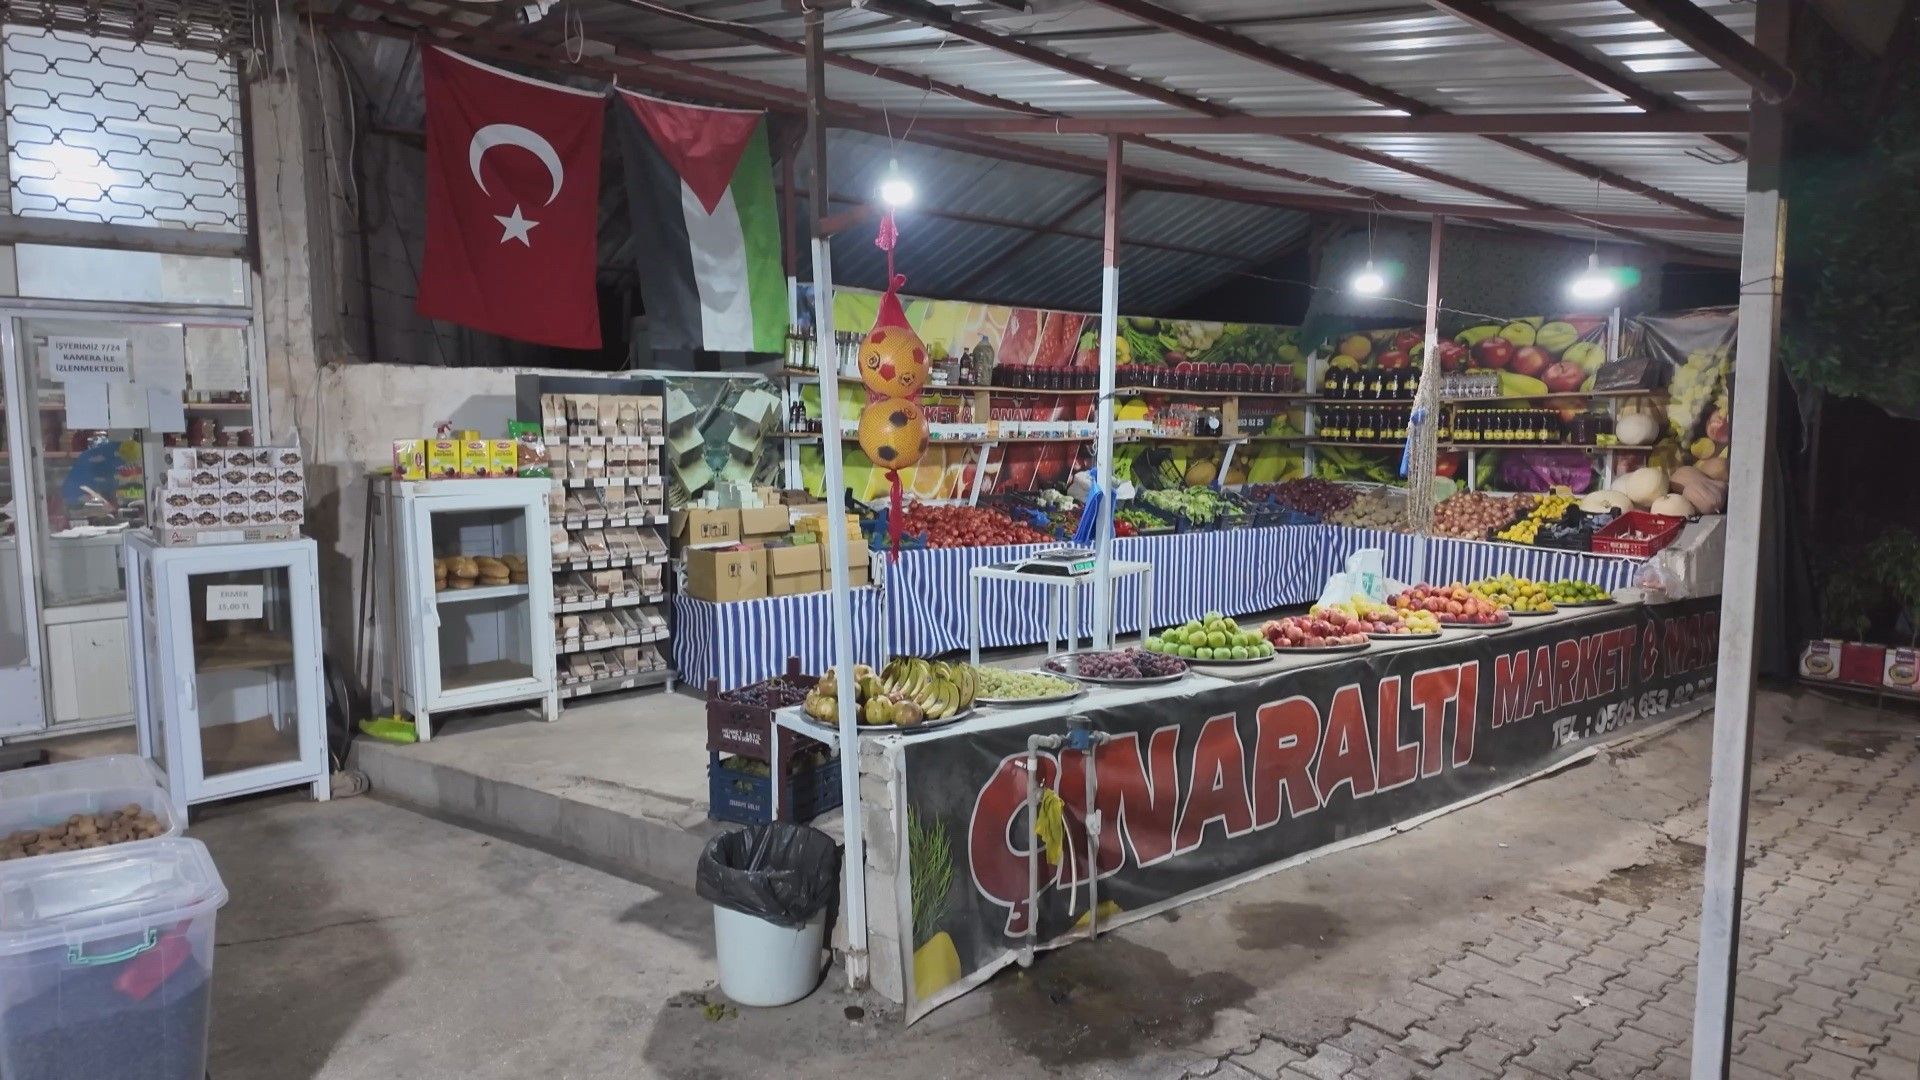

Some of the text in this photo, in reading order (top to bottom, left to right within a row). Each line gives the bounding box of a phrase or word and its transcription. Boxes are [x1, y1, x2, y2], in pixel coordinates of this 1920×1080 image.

[63, 353, 101, 361] KAMERA
[101, 343, 120, 351] 7/24
[1552, 714, 1580, 750] TEL
[968, 660, 1479, 938] ÇINARALTI
[1492, 625, 1638, 729] MARKET
